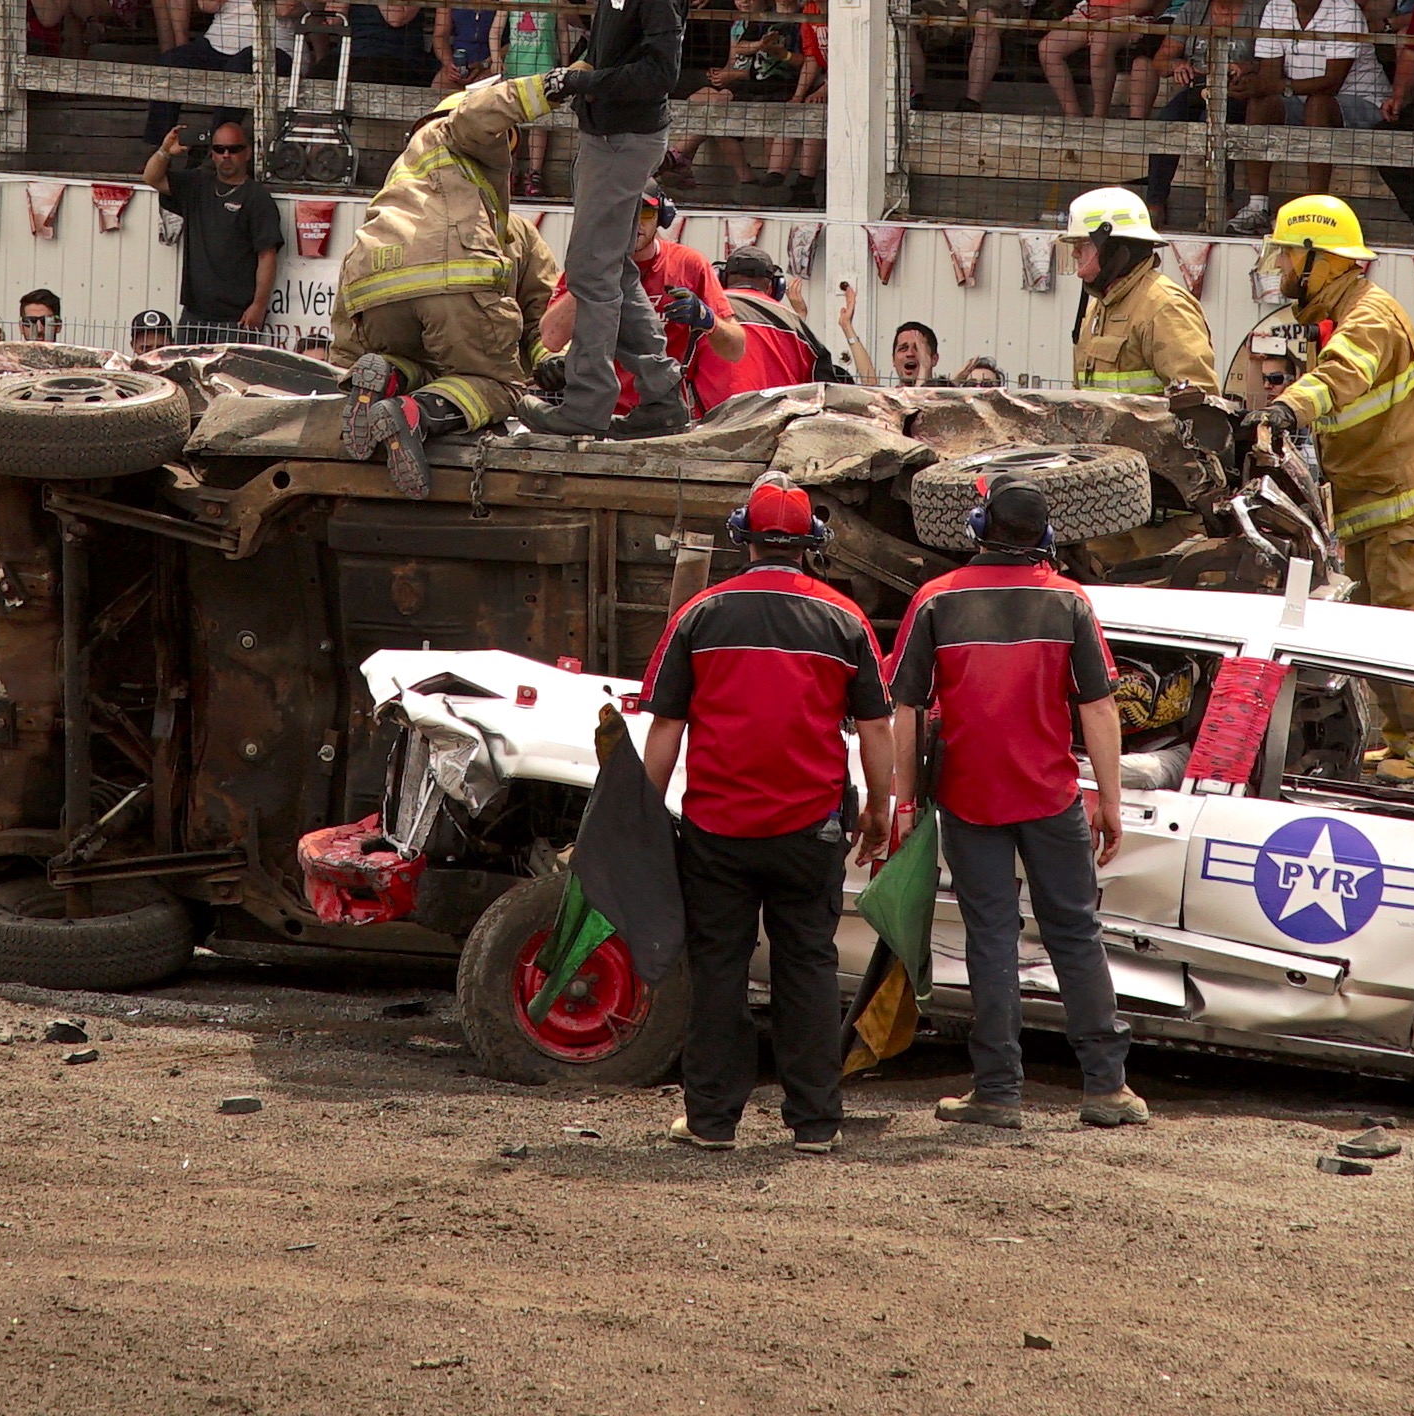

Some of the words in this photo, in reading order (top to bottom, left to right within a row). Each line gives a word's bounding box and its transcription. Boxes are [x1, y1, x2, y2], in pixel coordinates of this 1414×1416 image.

[1287, 214, 1338, 228] ORMSTOWN
[371, 245, 403, 272] OFD
[268, 279, 291, 315] al
[1282, 861, 1355, 897] PYR
